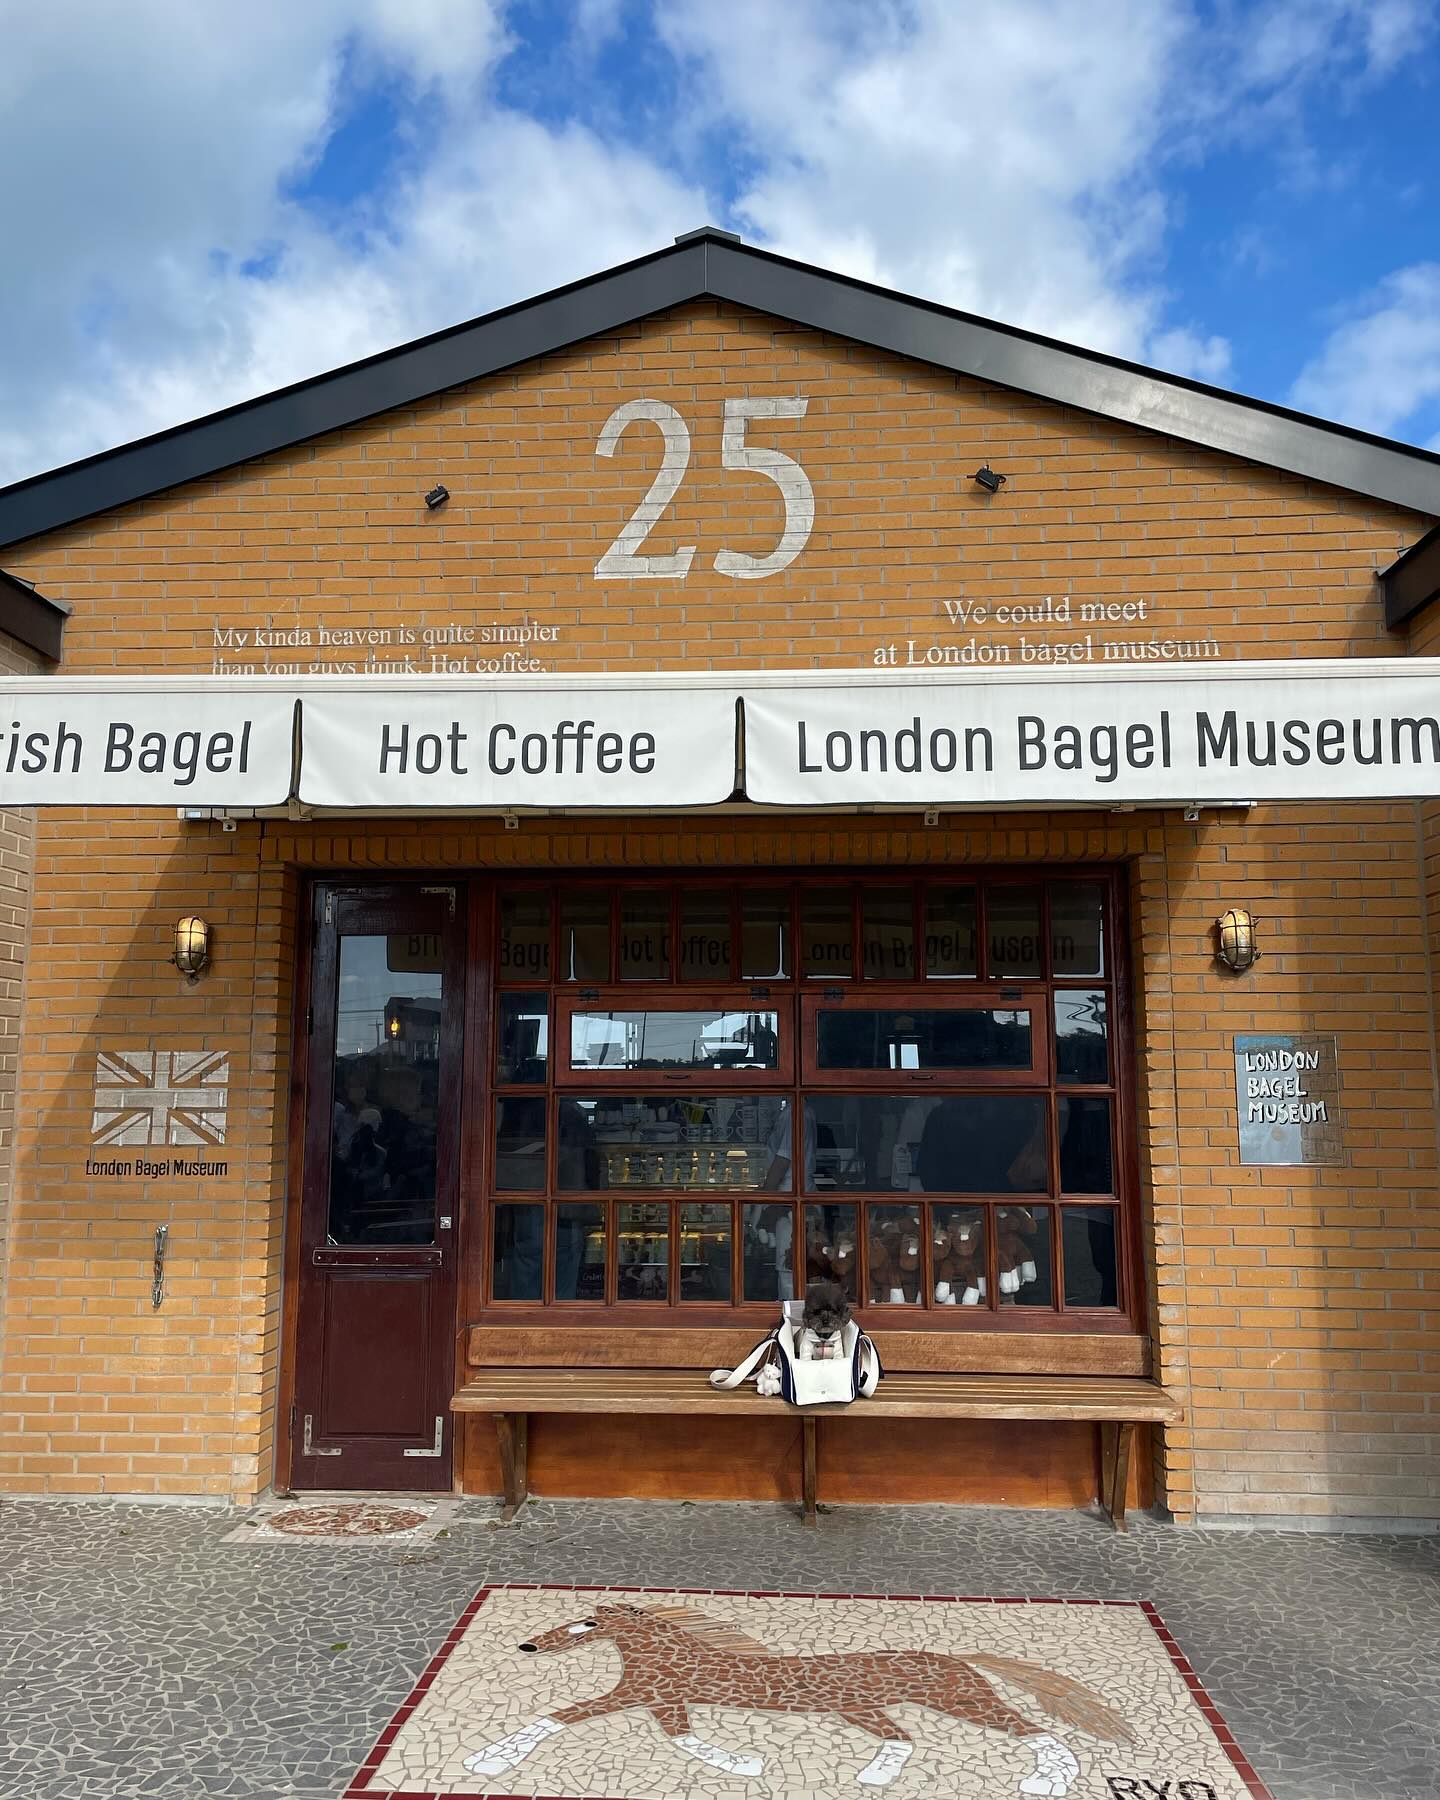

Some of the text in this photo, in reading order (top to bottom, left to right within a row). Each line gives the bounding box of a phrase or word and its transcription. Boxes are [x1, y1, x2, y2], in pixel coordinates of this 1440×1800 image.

[594, 395, 815, 580] 25
[943, 597, 1147, 625] We could meet
[213, 621, 560, 652] My kinda heaven is quite simpler
[873, 635, 1221, 665] at London bagel museum
[212, 658, 255, 675] than
[264, 662, 299, 675] you
[430, 654, 469, 673] Hot
[0, 720, 251, 786] ish Bagel
[379, 720, 655, 775] Hot Coffee
[798, 710, 1440, 783] London Bagel Museum
[1244, 1050, 1320, 1072] LONDON
[1247, 1076, 1309, 1100] BAGEL
[1248, 1101, 1328, 1124] MUSEUM
[86, 1159, 228, 1178] London Bagel Museum
